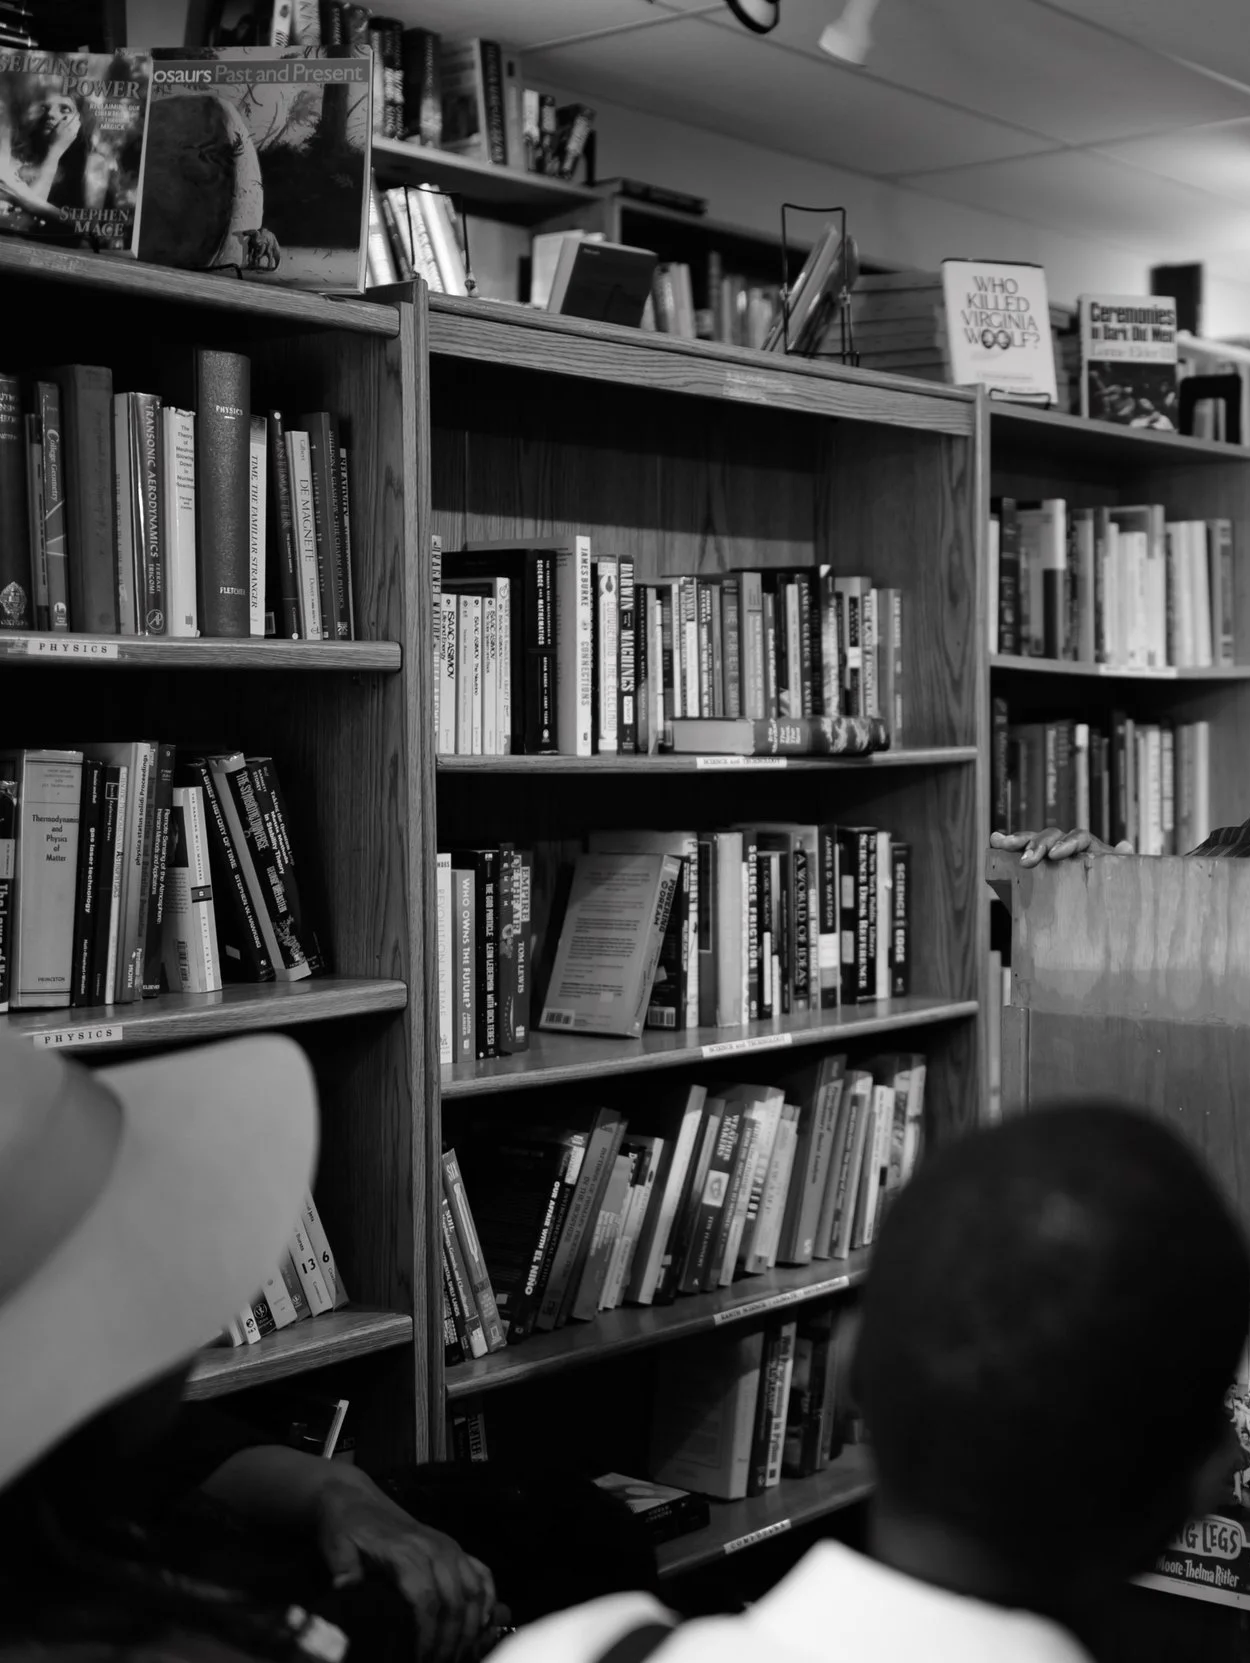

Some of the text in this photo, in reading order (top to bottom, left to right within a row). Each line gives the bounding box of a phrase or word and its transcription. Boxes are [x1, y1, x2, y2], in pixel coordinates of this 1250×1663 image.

[0, 55, 89, 77] SEIZING
[153, 63, 363, 83] osaurs Past and Present
[62, 76, 141, 99] POWER
[60, 205, 130, 221] STEPHEN
[75, 221, 125, 238] MACE
[972, 275, 1018, 295] WHO
[966, 292, 1030, 313] KILLED
[1090, 302, 1175, 325] Ceremonies
[961, 309, 1039, 332] VIRGINIA
[963, 327, 1041, 350] WOOLF?
[215, 404, 244, 417] PHYSICS
[47, 428, 60, 502] College Geometry
[144, 404, 159, 558] TRANSONIC AERODYNAMICS
[250, 484, 259, 504] THE
[299, 479, 310, 497] DE
[250, 506, 259, 554] FAMILIAR
[301, 499, 314, 562] MAGNETE
[250, 556, 259, 609] STRANGER
[536, 559, 545, 645] SCIENCE MATHEMATICS
[580, 547, 589, 706] JAMES BURKE CONNECTIONS
[620, 563, 634, 692] DARWIN MACHINES
[39, 642, 108, 655] PHYSICS
[139, 755, 148, 796] Proceedings
[138, 796, 146, 816] solidi
[51, 825, 63, 833] and
[162, 808, 170, 834] Remote
[46, 834, 68, 844] Physics
[53, 844, 61, 852] of
[159, 834, 168, 863] Sensing
[265, 821, 279, 849] Stability
[272, 849, 285, 874] Theory
[825, 836, 833, 868] JAMES
[45, 853, 67, 862] Matter
[133, 840, 143, 866] physica
[203, 775, 214, 800] BRIEF
[210, 800, 225, 836] HISTORY
[221, 836, 230, 846] OF
[226, 847, 238, 869] TIME
[234, 874, 247, 906] STEPHEN
[246, 914, 261, 948] HAWKING
[85, 827, 96, 913] gas laser technology
[485, 883, 493, 895] THE
[520, 868, 529, 921] EMPIRE
[797, 867, 807, 922] WORLD
[653, 889, 666, 926] DREAM
[658, 878, 677, 933] POWERING
[748, 844, 758, 969] SCIENCE FRICTION
[825, 884, 834, 927] WATSON
[858, 833, 868, 989] SCIENCE DESK REFERENCE
[895, 863, 905, 963] SCIENCE EDGE
[485, 908, 494, 937] PARTICLE
[797, 925, 806, 942] OF
[462, 878, 471, 1008] WHO OWNS THE FUTURE?
[797, 947, 807, 987] IDEAS
[44, 1027, 114, 1045] PHYSICS
[717, 1115, 732, 1158] MAKERS
[723, 1114, 739, 1160] WEATHER
[550, 1181, 560, 1199] OUR
[445, 1210, 455, 1233] SOIL
[544, 1200, 556, 1226] AFFAIR
[537, 1228, 548, 1249] WITH
[322, 1251, 330, 1263] 6
[532, 1249, 543, 1262] EL
[1202, 1521, 1240, 1554] LEGS
[1185, 1559, 1215, 1582] Thelma
[1215, 1564, 1240, 1588] Ritter
